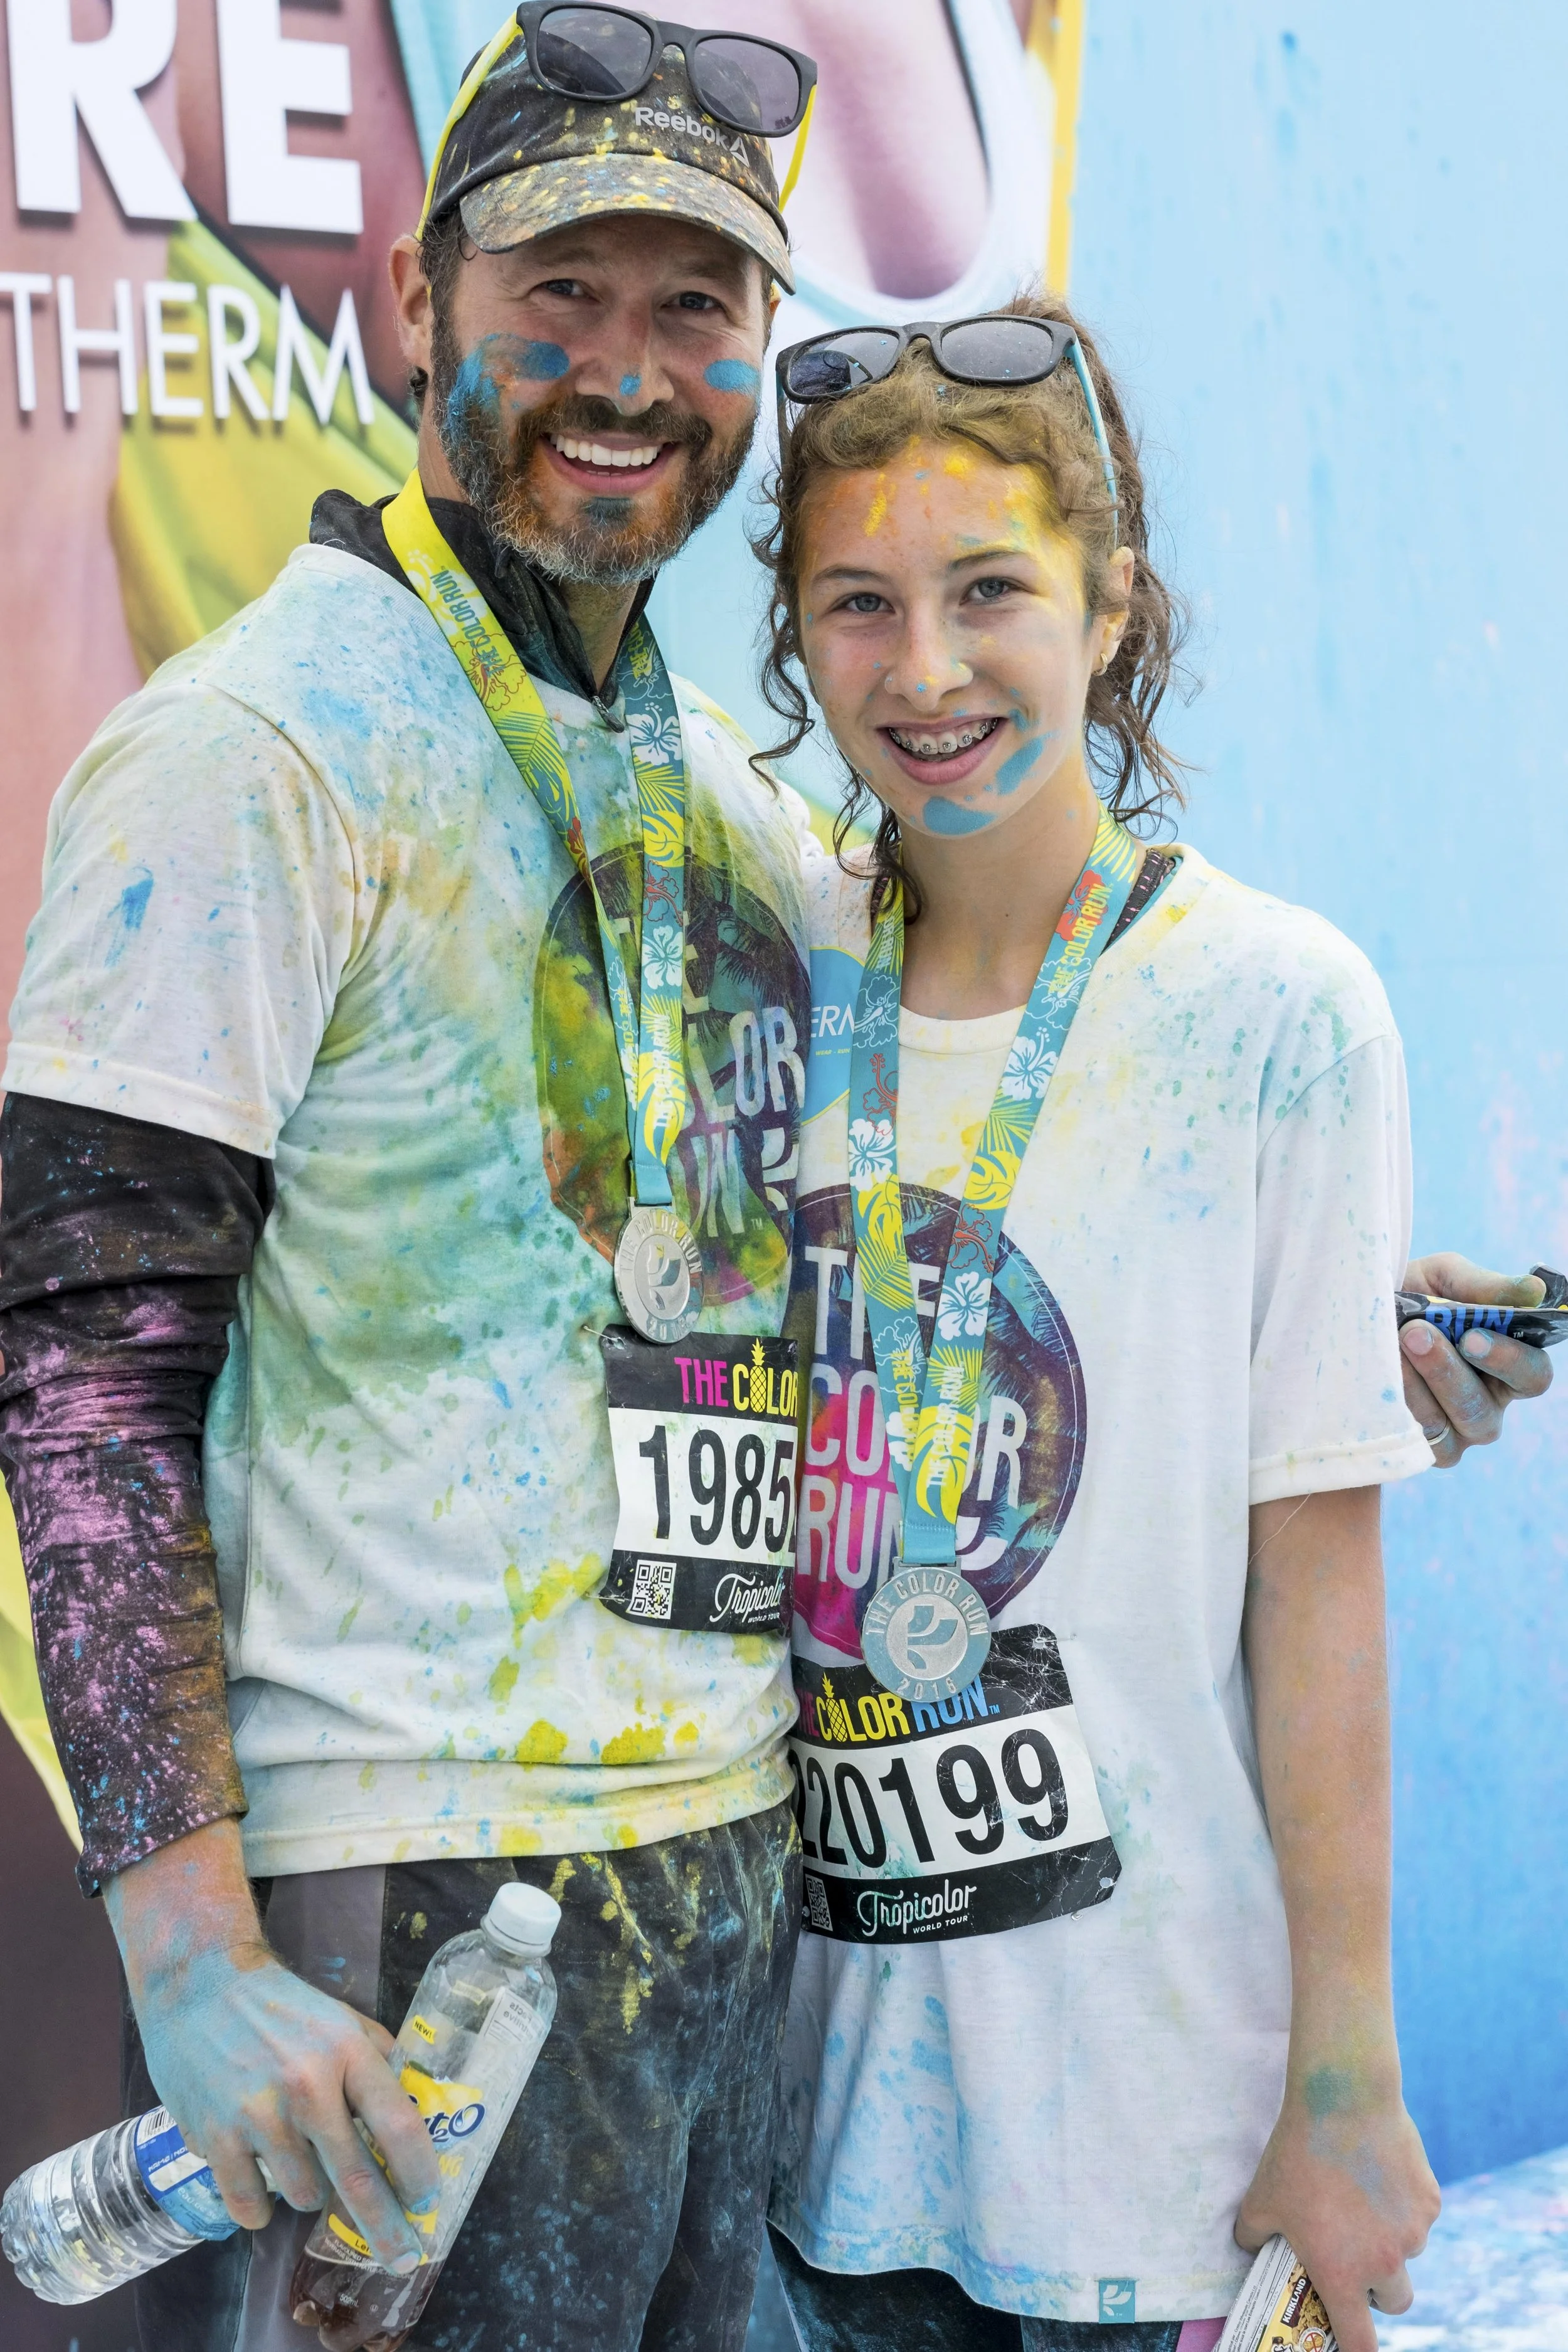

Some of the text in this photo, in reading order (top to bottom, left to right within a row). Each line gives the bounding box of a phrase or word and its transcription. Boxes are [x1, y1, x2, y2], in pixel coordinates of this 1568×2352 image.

[5, 0, 364, 235] RE
[635, 107, 729, 147] Reebok
[0, 273, 375, 425] THERM
[430, 569, 506, 678] THE COLOR RUN
[1060, 916, 1097, 967] COLOR
[1081, 882, 1113, 919] RUN
[685, 1006, 805, 1126] LOR
[620, 1209, 703, 1274] THE COLOR RUN
[674, 1357, 729, 1407] THE
[890, 1348, 914, 1380] THE
[940, 1365, 965, 1401] RUN
[747, 1612, 780, 1623] WORLD TOUR
[866, 1572, 988, 1636] THE COLOR RUN
[816, 1682, 911, 1742] COLOR
[989, 1704, 1000, 1715] TM
[896, 1677, 956, 1700] 2016
[857, 1878, 977, 1936] Tropicolor
[912, 1914, 969, 1934] WORLD TOUR
[414, 2020, 433, 2039] NEW!
[1282, 2278, 1306, 2324] KIRKLAND
